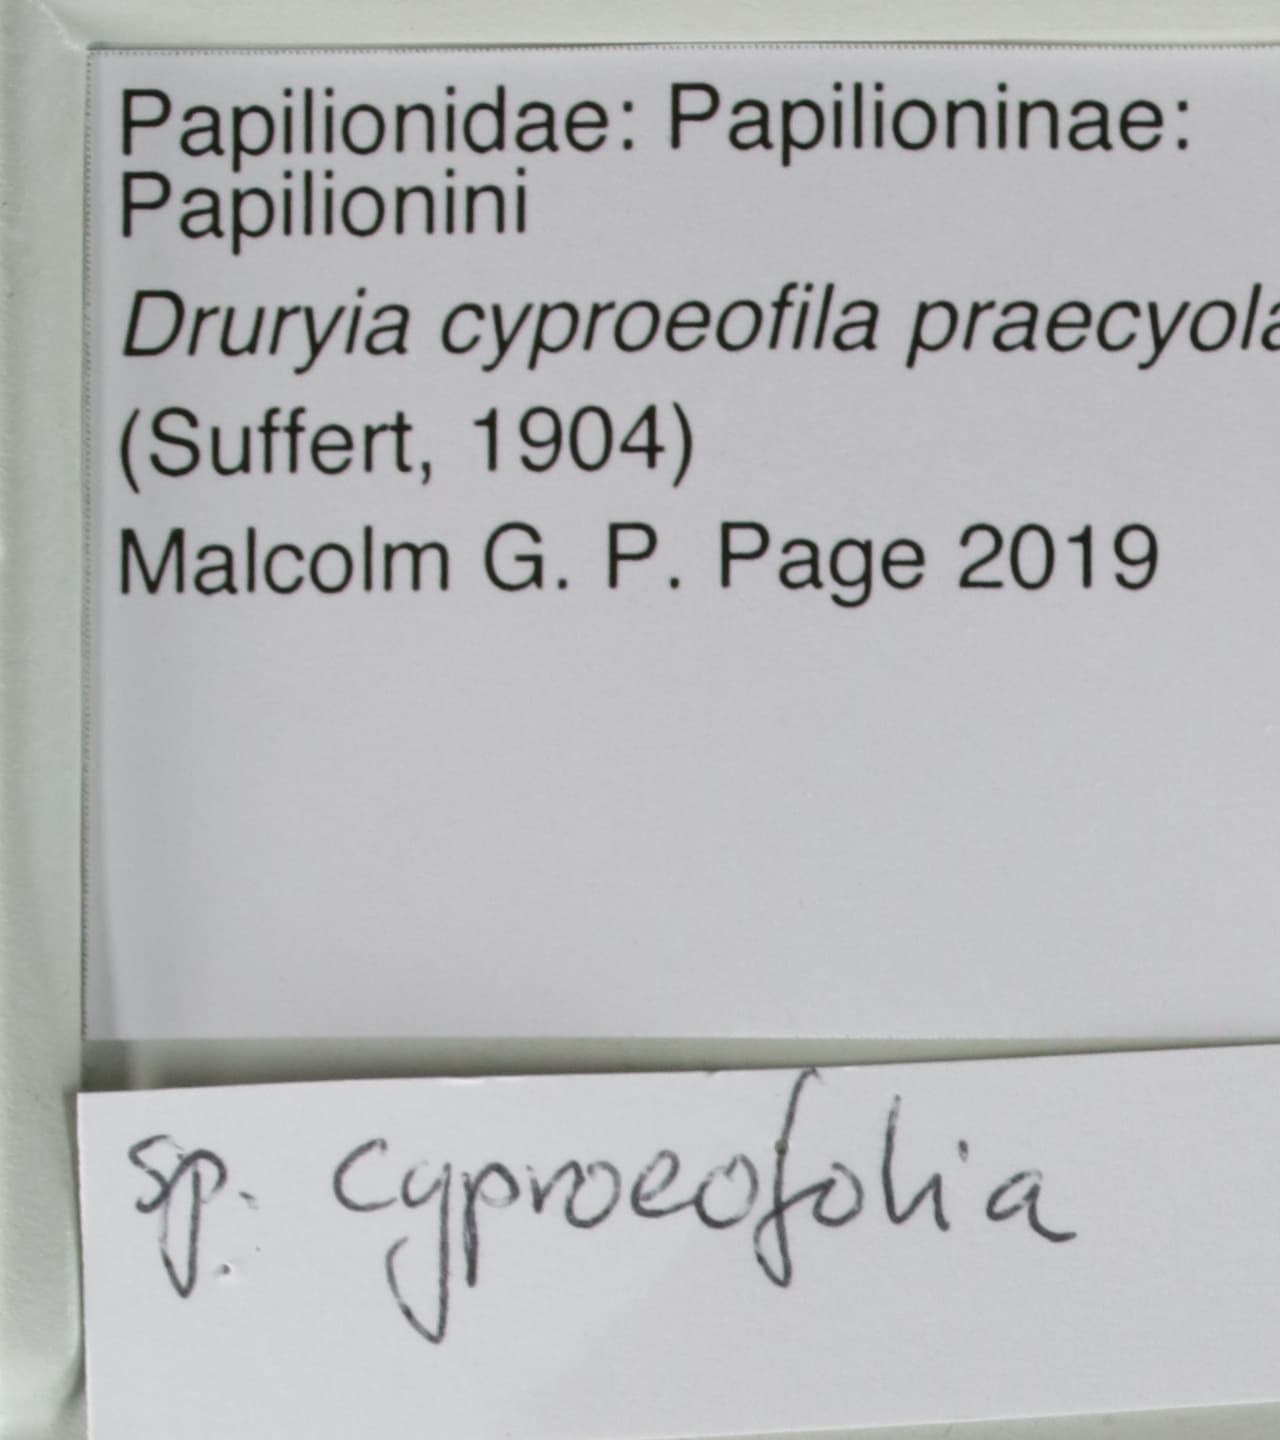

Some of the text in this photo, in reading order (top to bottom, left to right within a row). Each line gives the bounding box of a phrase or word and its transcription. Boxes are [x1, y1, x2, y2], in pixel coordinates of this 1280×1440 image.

[118, 80, 1189, 172] Papilionidae: Papilioninae:
[118, 168, 529, 257] Papilionini
[121, 286, 411, 377] Druryia
[440, 280, 881, 374] cyproeofila
[118, 400, 694, 496] (Suffert, 1904)
[119, 520, 1160, 610] Malcolm G. P. Page 2019
[126, 1133, 255, 1301] sp.
